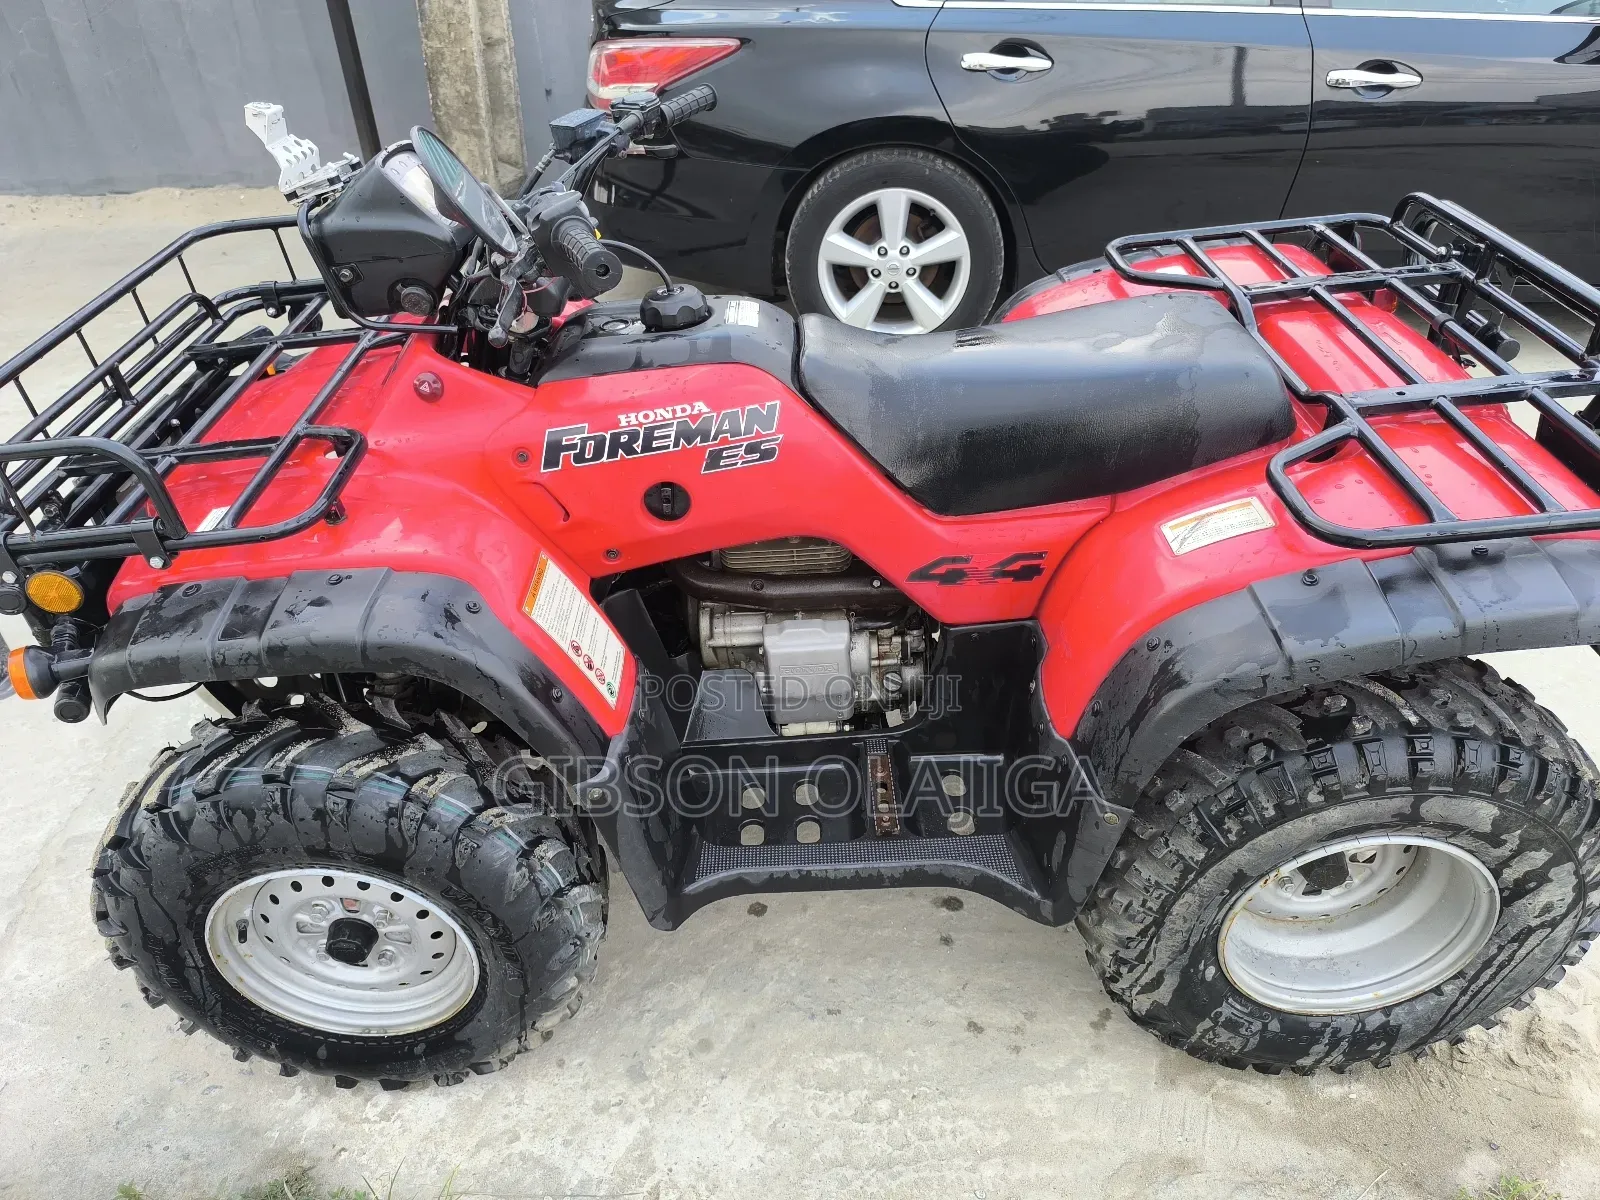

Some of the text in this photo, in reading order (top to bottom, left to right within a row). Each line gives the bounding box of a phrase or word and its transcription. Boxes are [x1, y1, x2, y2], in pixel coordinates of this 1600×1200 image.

[617, 401, 711, 427] HONDA
[540, 400, 780, 473] FOREMAN
[701, 434, 784, 474] ES
[780, 664, 838, 675] HONDA
